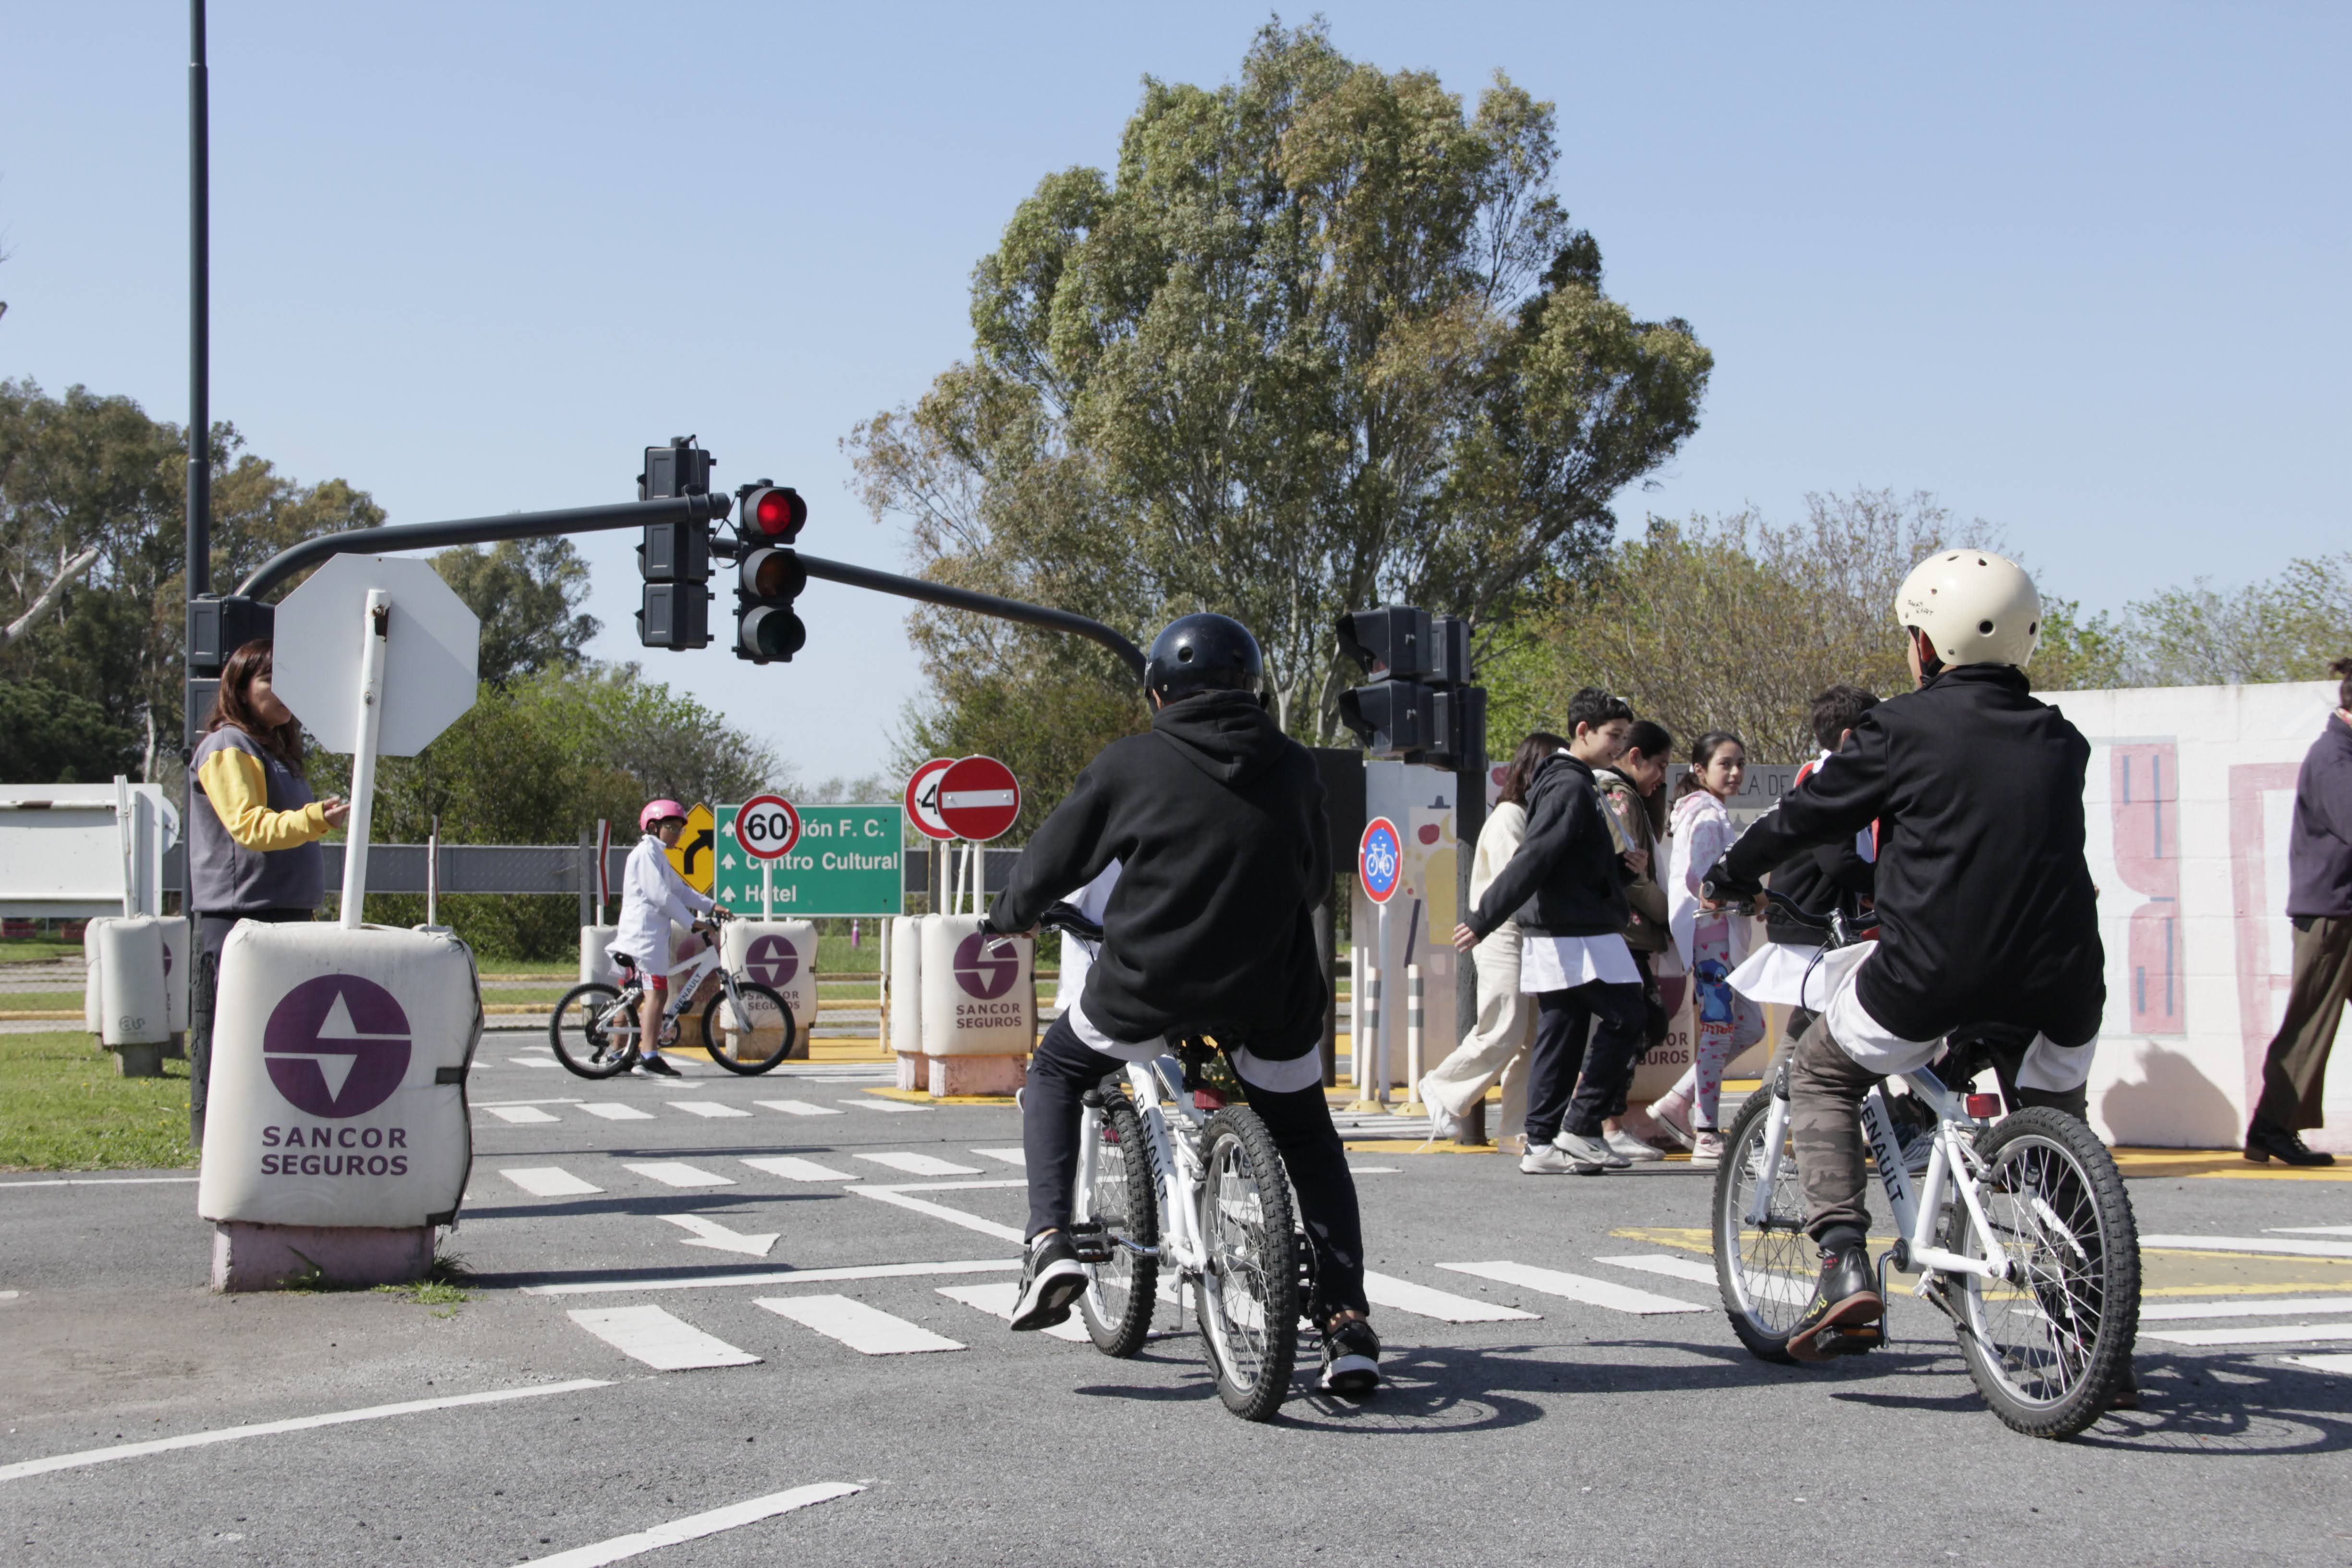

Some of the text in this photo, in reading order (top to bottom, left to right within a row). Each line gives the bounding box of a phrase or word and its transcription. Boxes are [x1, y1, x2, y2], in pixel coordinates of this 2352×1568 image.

[921, 783, 938, 814] 4
[748, 813, 788, 840] 60
[839, 819, 857, 837] F.
[864, 819, 885, 837] C.
[745, 852, 898, 870] Cntro Cultural
[674, 972, 702, 1009] RENAULT
[748, 991, 799, 1000] SAOR
[956, 1003, 1021, 1016] SANCOR
[956, 1016, 1022, 1029] SEGUROS
[262, 1126, 407, 1148] SANCOR
[1137, 1093, 1168, 1202] RENAULT
[261, 1154, 408, 1176] SEGUROS
